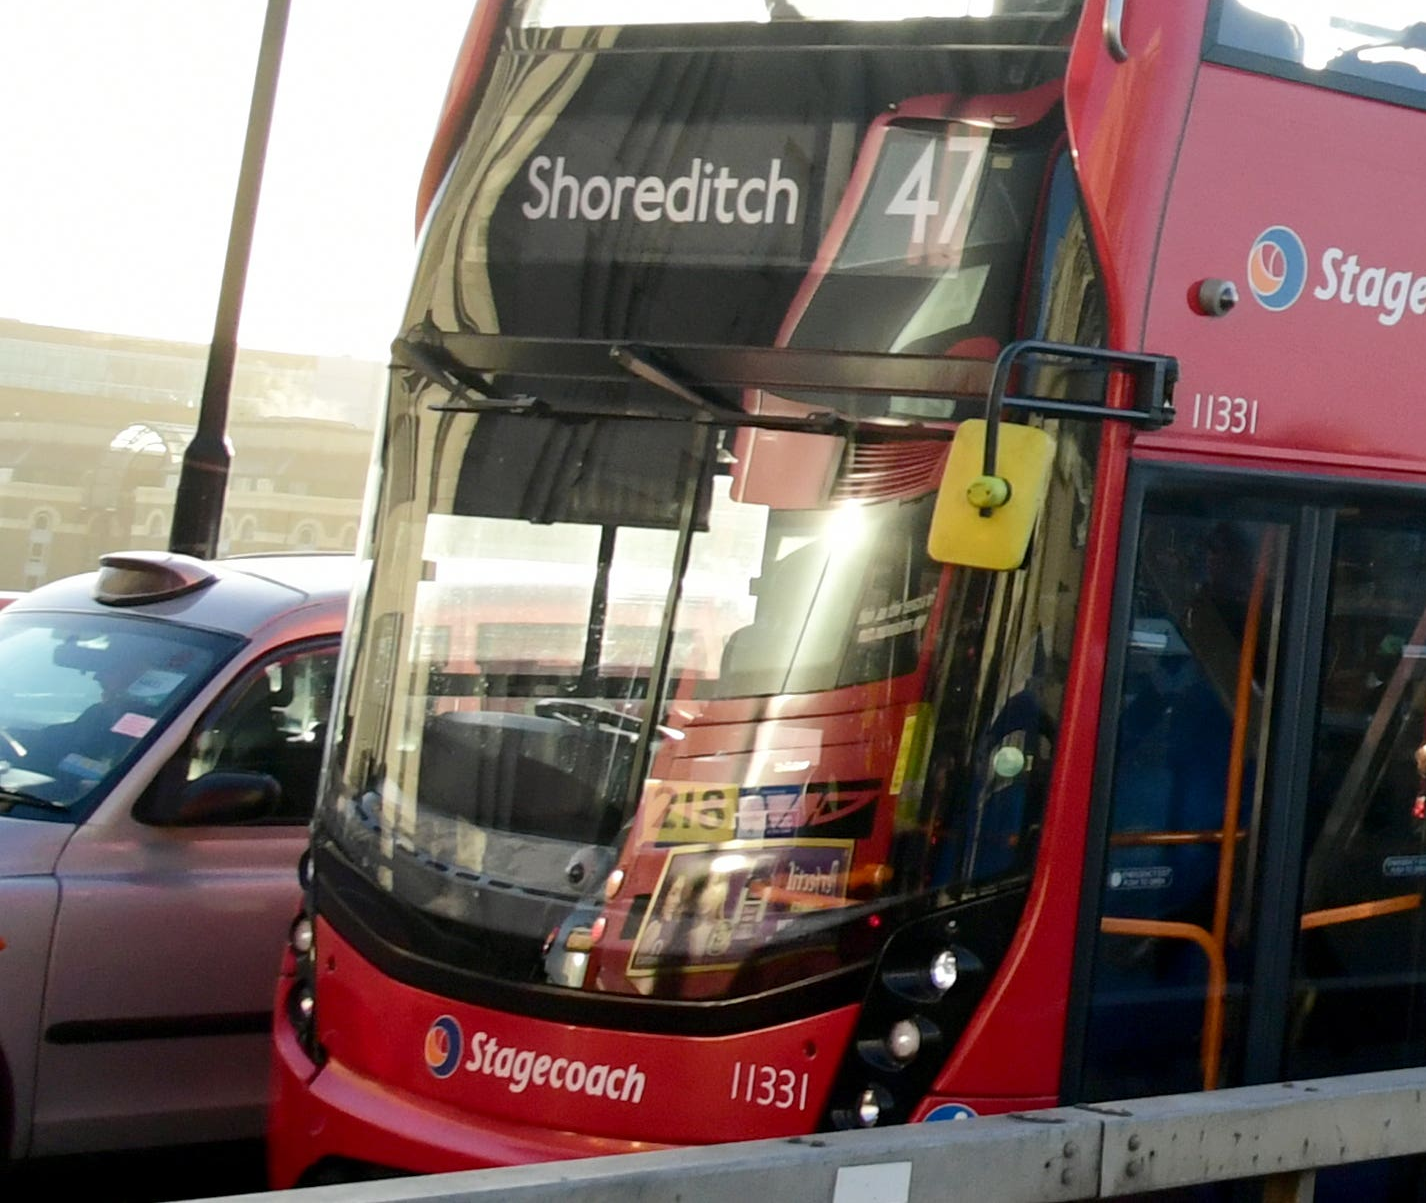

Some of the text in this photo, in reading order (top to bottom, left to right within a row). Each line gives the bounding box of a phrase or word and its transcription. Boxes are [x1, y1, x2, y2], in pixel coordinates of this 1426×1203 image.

[522, 136, 990, 244] Shoreditch 47
[1192, 393, 1258, 434] 11331
[465, 1032, 647, 1103] Stagecoach
[731, 1062, 809, 1111] 11331
